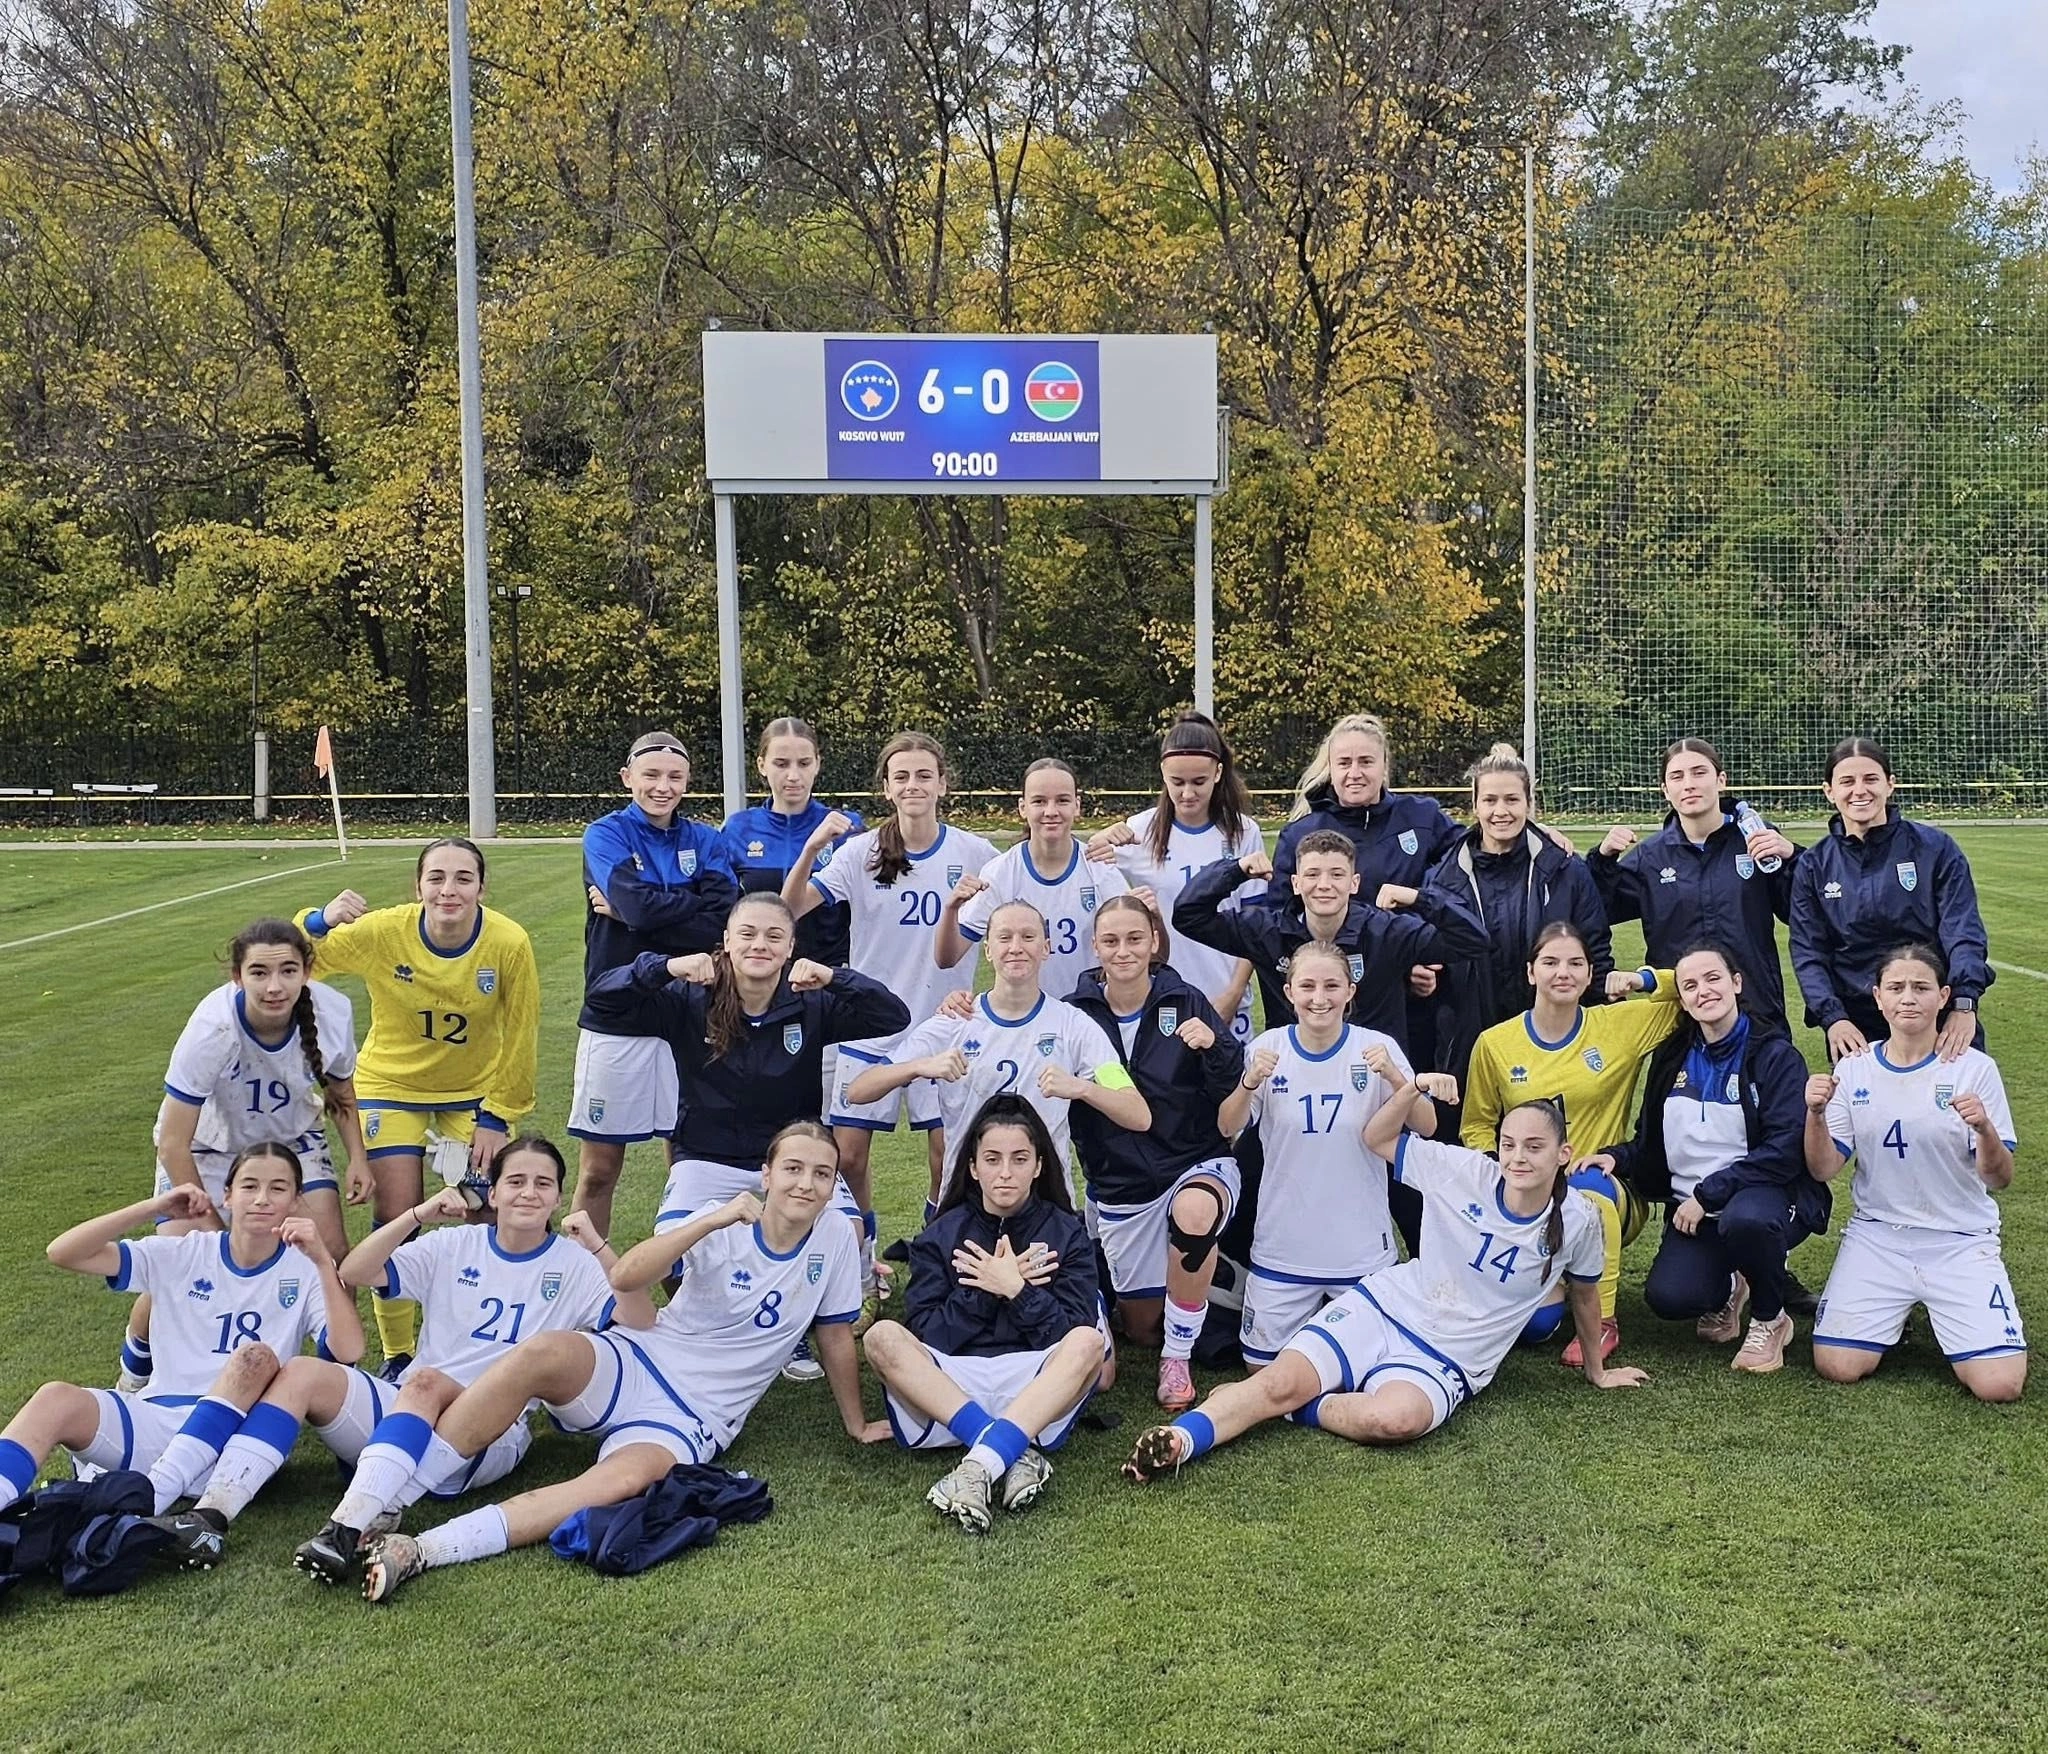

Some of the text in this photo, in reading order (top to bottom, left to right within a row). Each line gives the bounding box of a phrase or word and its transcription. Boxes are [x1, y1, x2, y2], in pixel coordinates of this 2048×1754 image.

[838, 431, 906, 442] KOSOVO WU17
[1009, 431, 1099, 443] AZERBAIJAN WU17
[931, 452, 998, 477] 90:00
[899, 890, 942, 926] 20
[417, 1010, 468, 1045] 12
[996, 1059, 1019, 1095] 2
[245, 1078, 291, 1114] 19
[1298, 1093, 1343, 1134] 17
[1882, 1119, 1909, 1159] 4
[1468, 1231, 1520, 1283] 14
[187, 1289, 210, 1301] errea
[730, 1282, 751, 1291] errea
[1989, 1283, 2011, 1321] 4
[471, 1296, 528, 1344] 21
[753, 1289, 782, 1329] 8
[210, 1310, 263, 1354] 18
